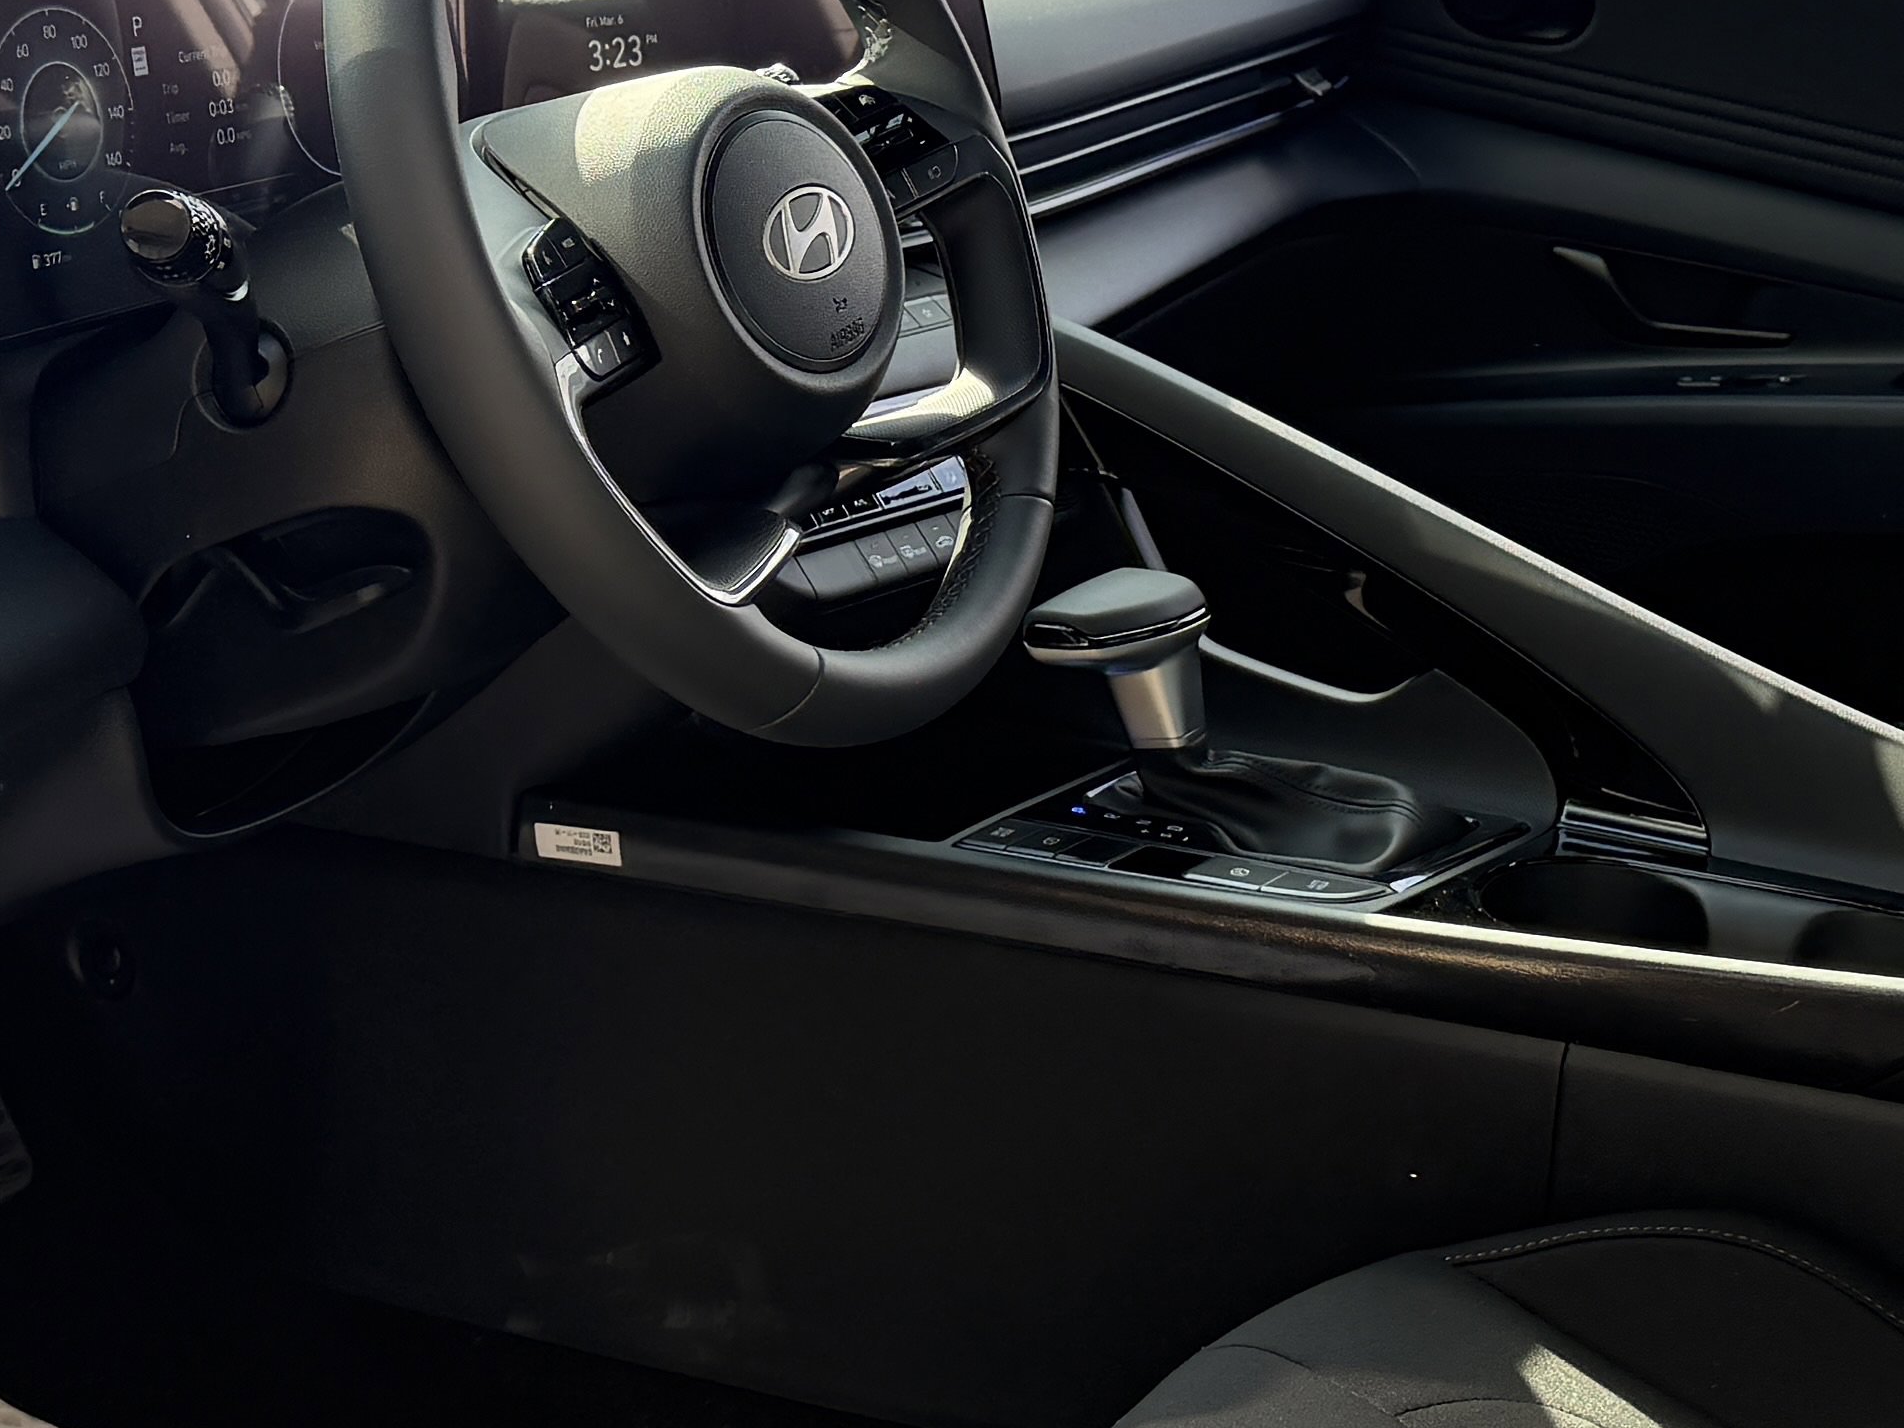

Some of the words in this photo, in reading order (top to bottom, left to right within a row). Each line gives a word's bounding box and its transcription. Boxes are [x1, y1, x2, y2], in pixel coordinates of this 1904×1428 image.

[132, 16, 142, 37] P
[617, 15, 624, 25] 6
[43, 24, 57, 39] 80
[70, 34, 88, 50] 100
[16, 43, 29, 58] 60
[588, 35, 643, 72] 3:23
[93, 61, 110, 77] 120
[0, 78, 14, 92] 40
[212, 69, 231, 87] 0.0
[108, 105, 125, 120] 140
[208, 98, 234, 118] 0:03
[216, 127, 236, 145] 0.0
[105, 152, 123, 167] 160
[40, 203, 47, 217] E
[45, 251, 62, 266] 377
